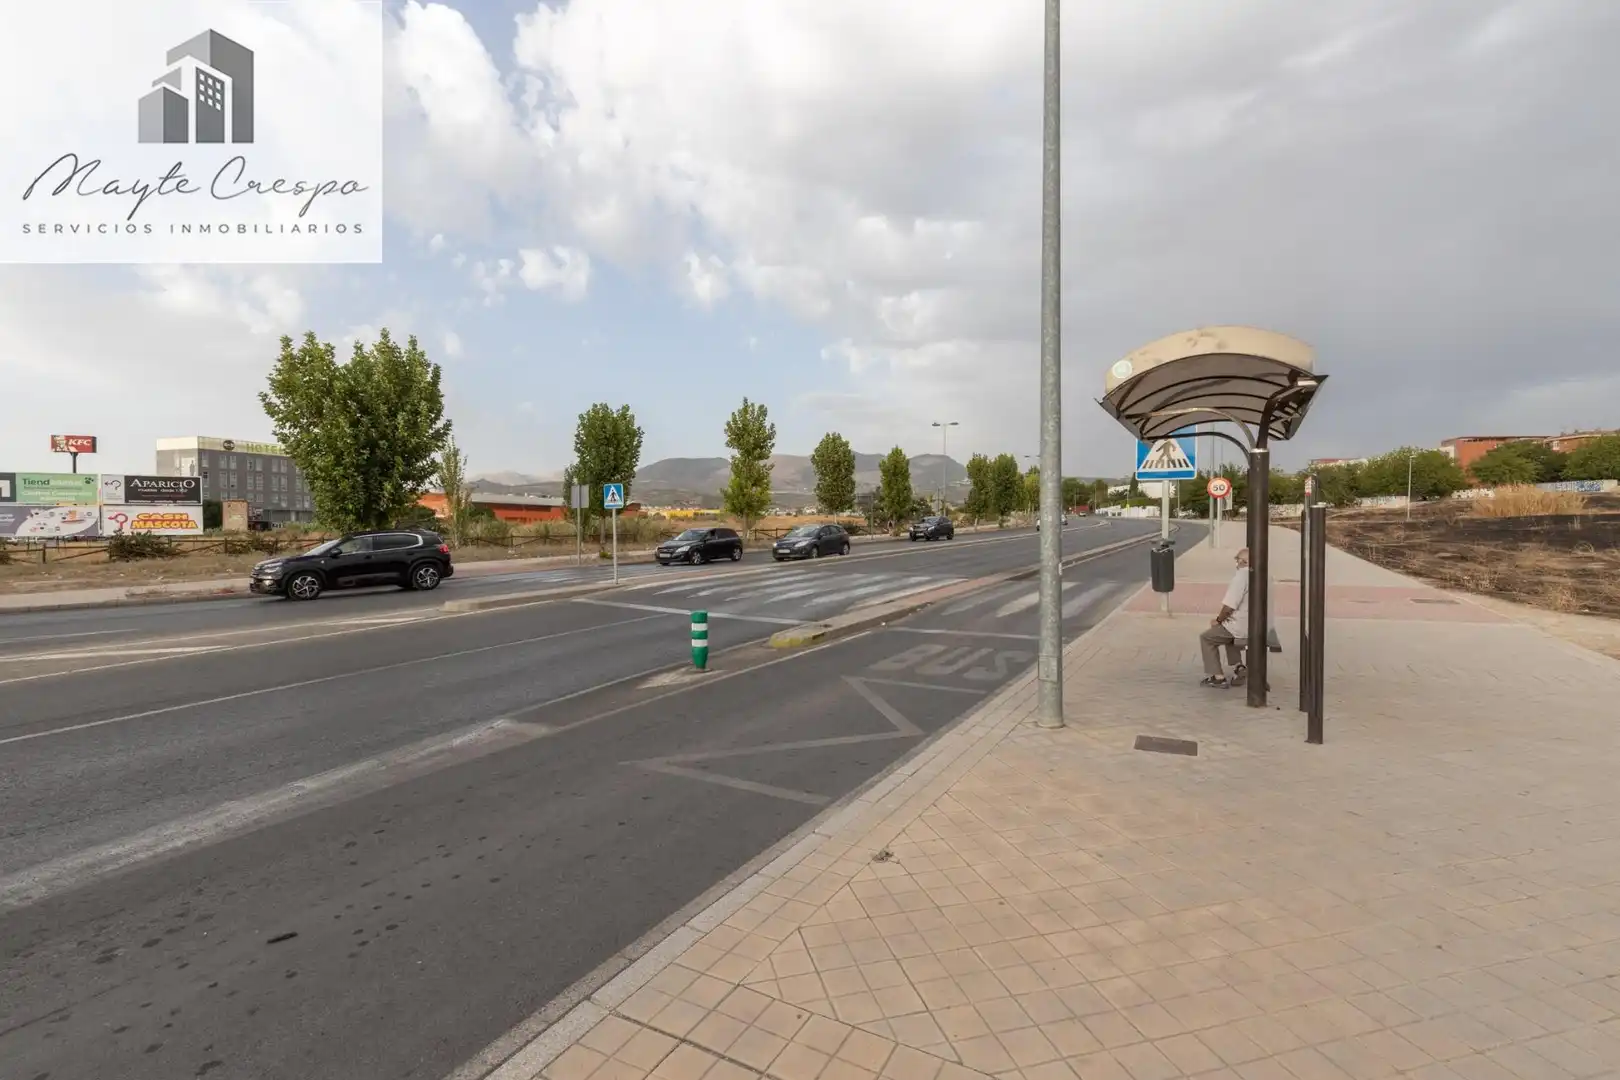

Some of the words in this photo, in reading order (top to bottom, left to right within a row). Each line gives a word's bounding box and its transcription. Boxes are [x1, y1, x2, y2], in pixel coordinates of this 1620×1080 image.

[68, 438, 92, 446] KFC
[130, 478, 195, 488] APARICIO
[1212, 483, 1226, 492] 50
[136, 513, 189, 521] CASH
[130, 520, 198, 530] MASCOTA
[868, 643, 1036, 680] BUS
